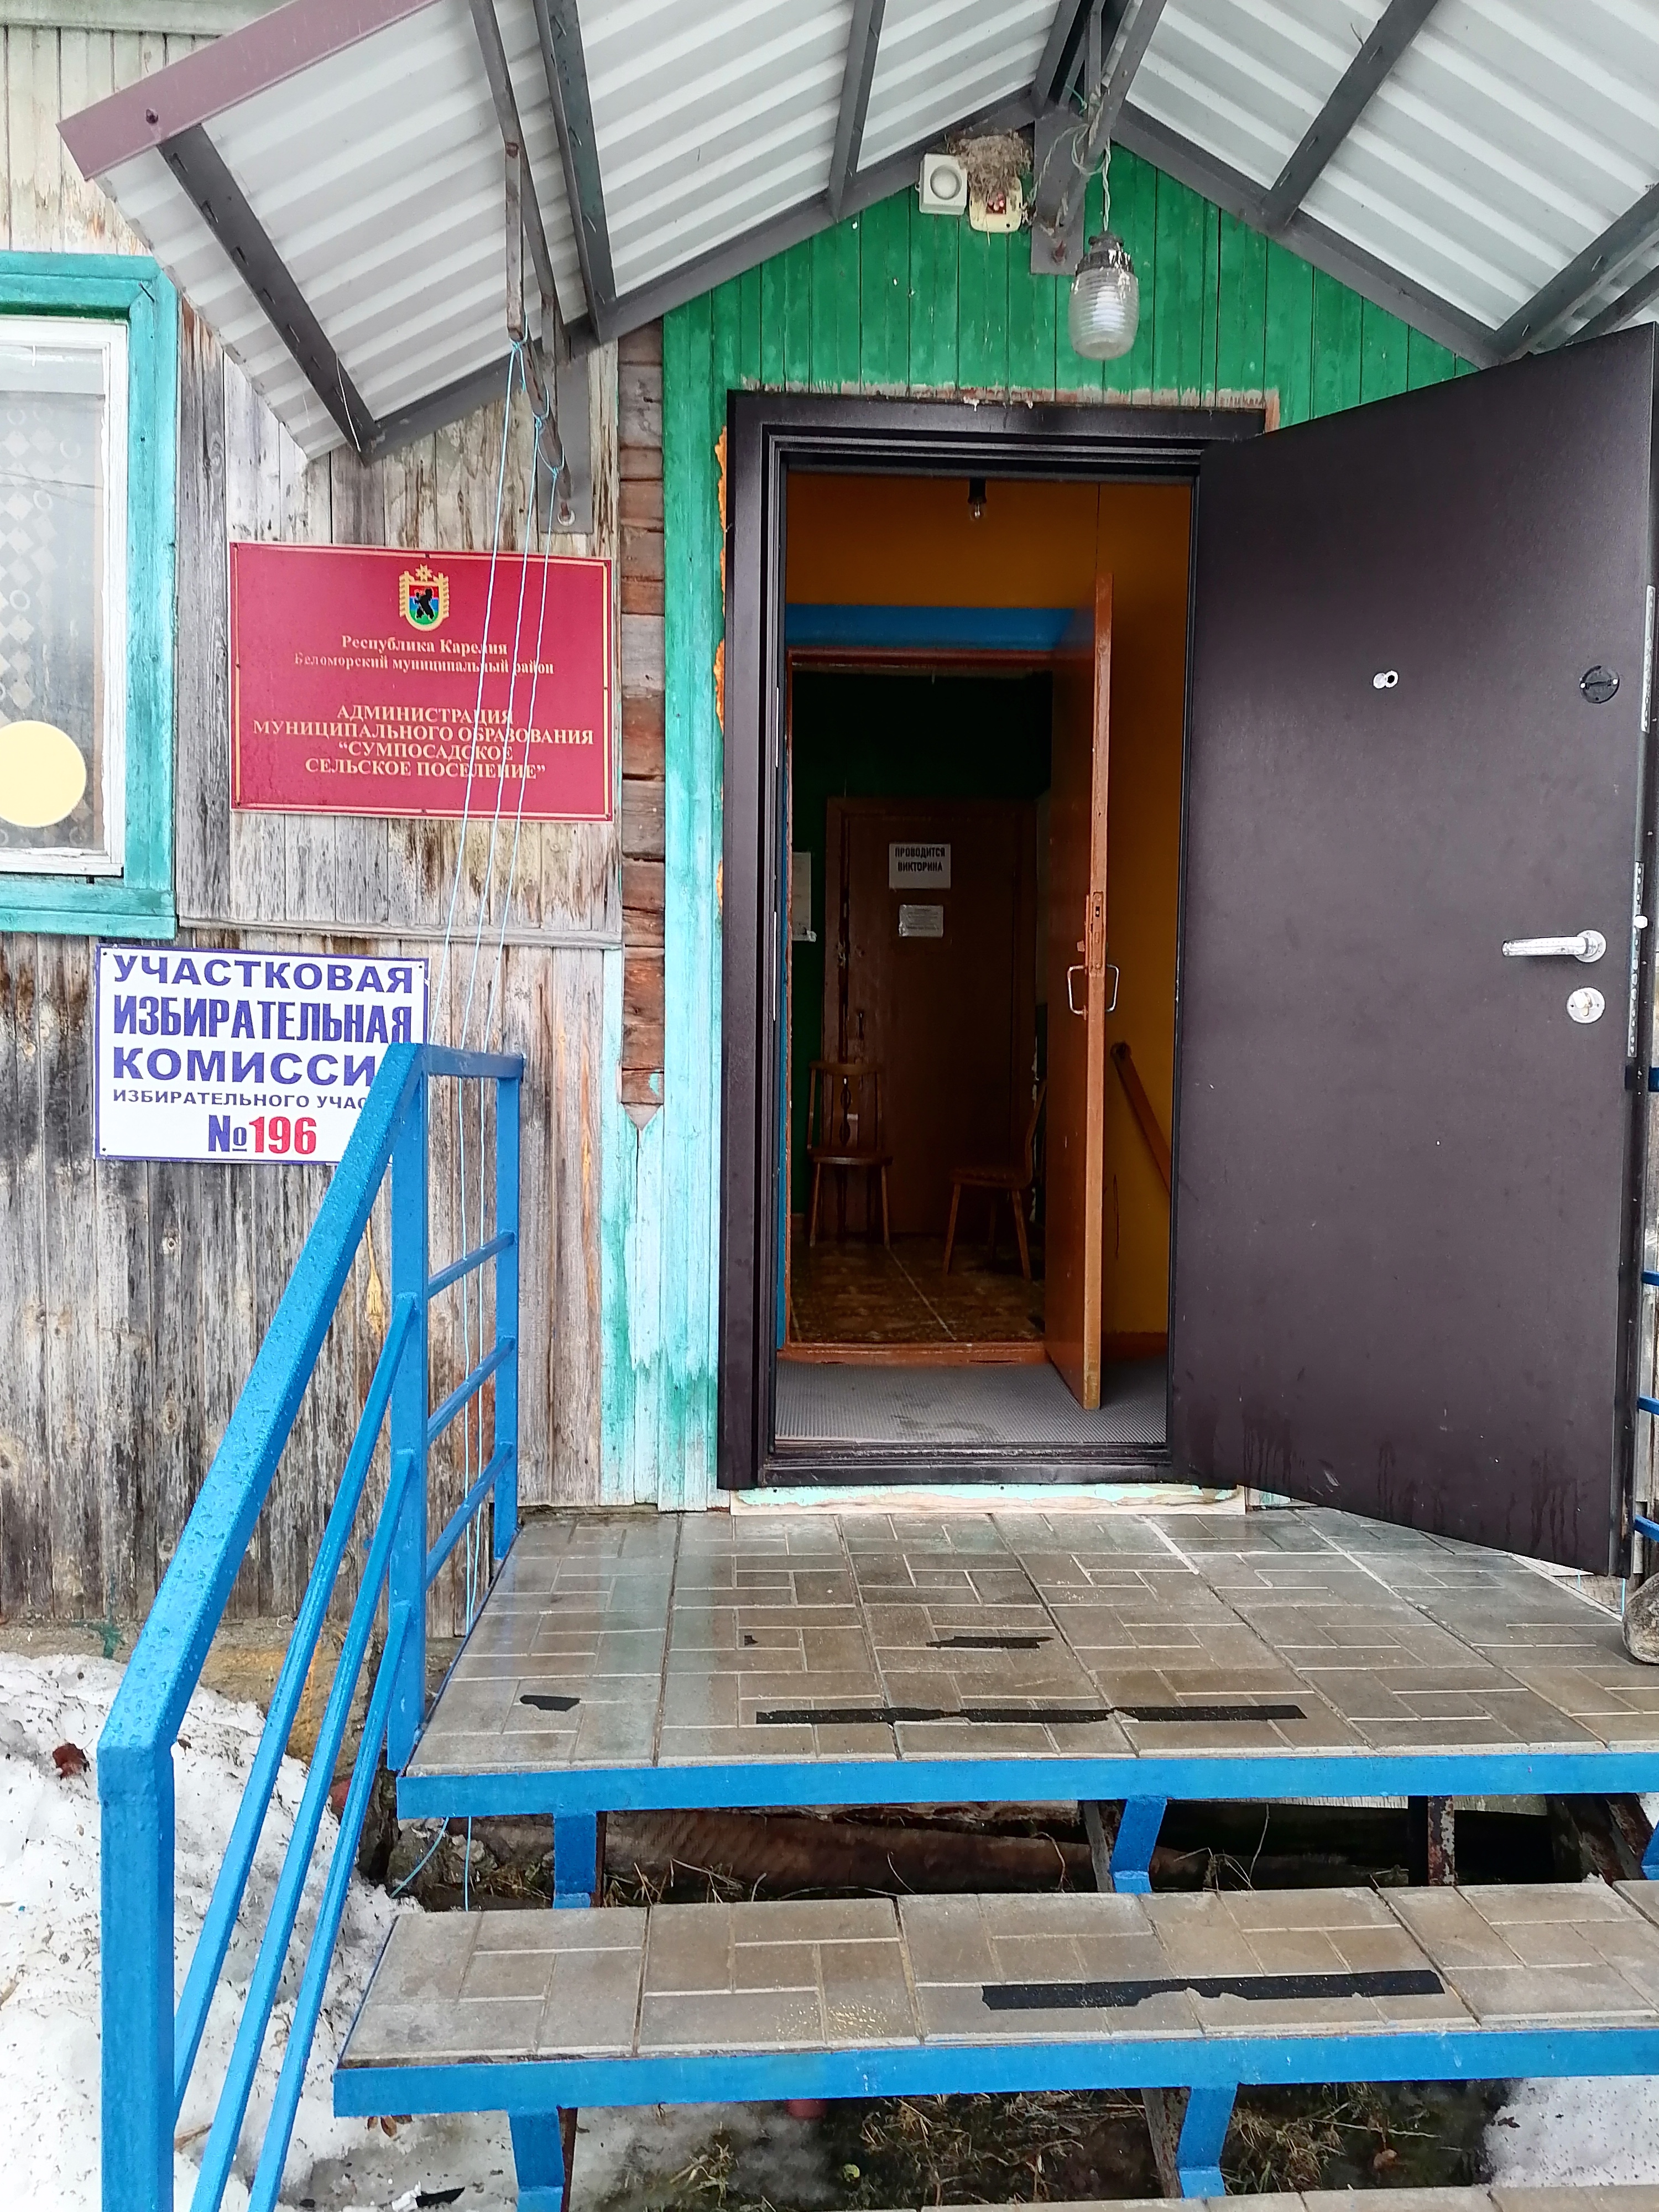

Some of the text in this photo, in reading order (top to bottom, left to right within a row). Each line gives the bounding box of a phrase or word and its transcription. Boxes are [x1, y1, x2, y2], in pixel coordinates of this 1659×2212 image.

[341, 634, 435, 654] Республика
[295, 652, 388, 670] Беломорский
[513, 659, 554, 676] район
[337, 705, 514, 726] АДМИНИСТРАЦИЯ
[253, 719, 594, 744] МУНИЦИПАЛЬНОГО ОБРАЗОВАНИЯ
[305, 758, 411, 776] СЕЛЬСКОЕ
[895, 847, 945, 858] ПРОВОДИТСЯ
[898, 862, 942, 872] ВИКТОРИНА
[113, 954, 413, 994] УЧАСТКОВАЯ
[113, 995, 412, 1043] ИЗБИРАТЕЛЬНАЯ
[113, 1047, 376, 1087] КОМИССИ
[113, 1089, 367, 1109] ИЗБИРАТЕЛЬНОГО УЧАС
[208, 1114, 317, 1154] №196
